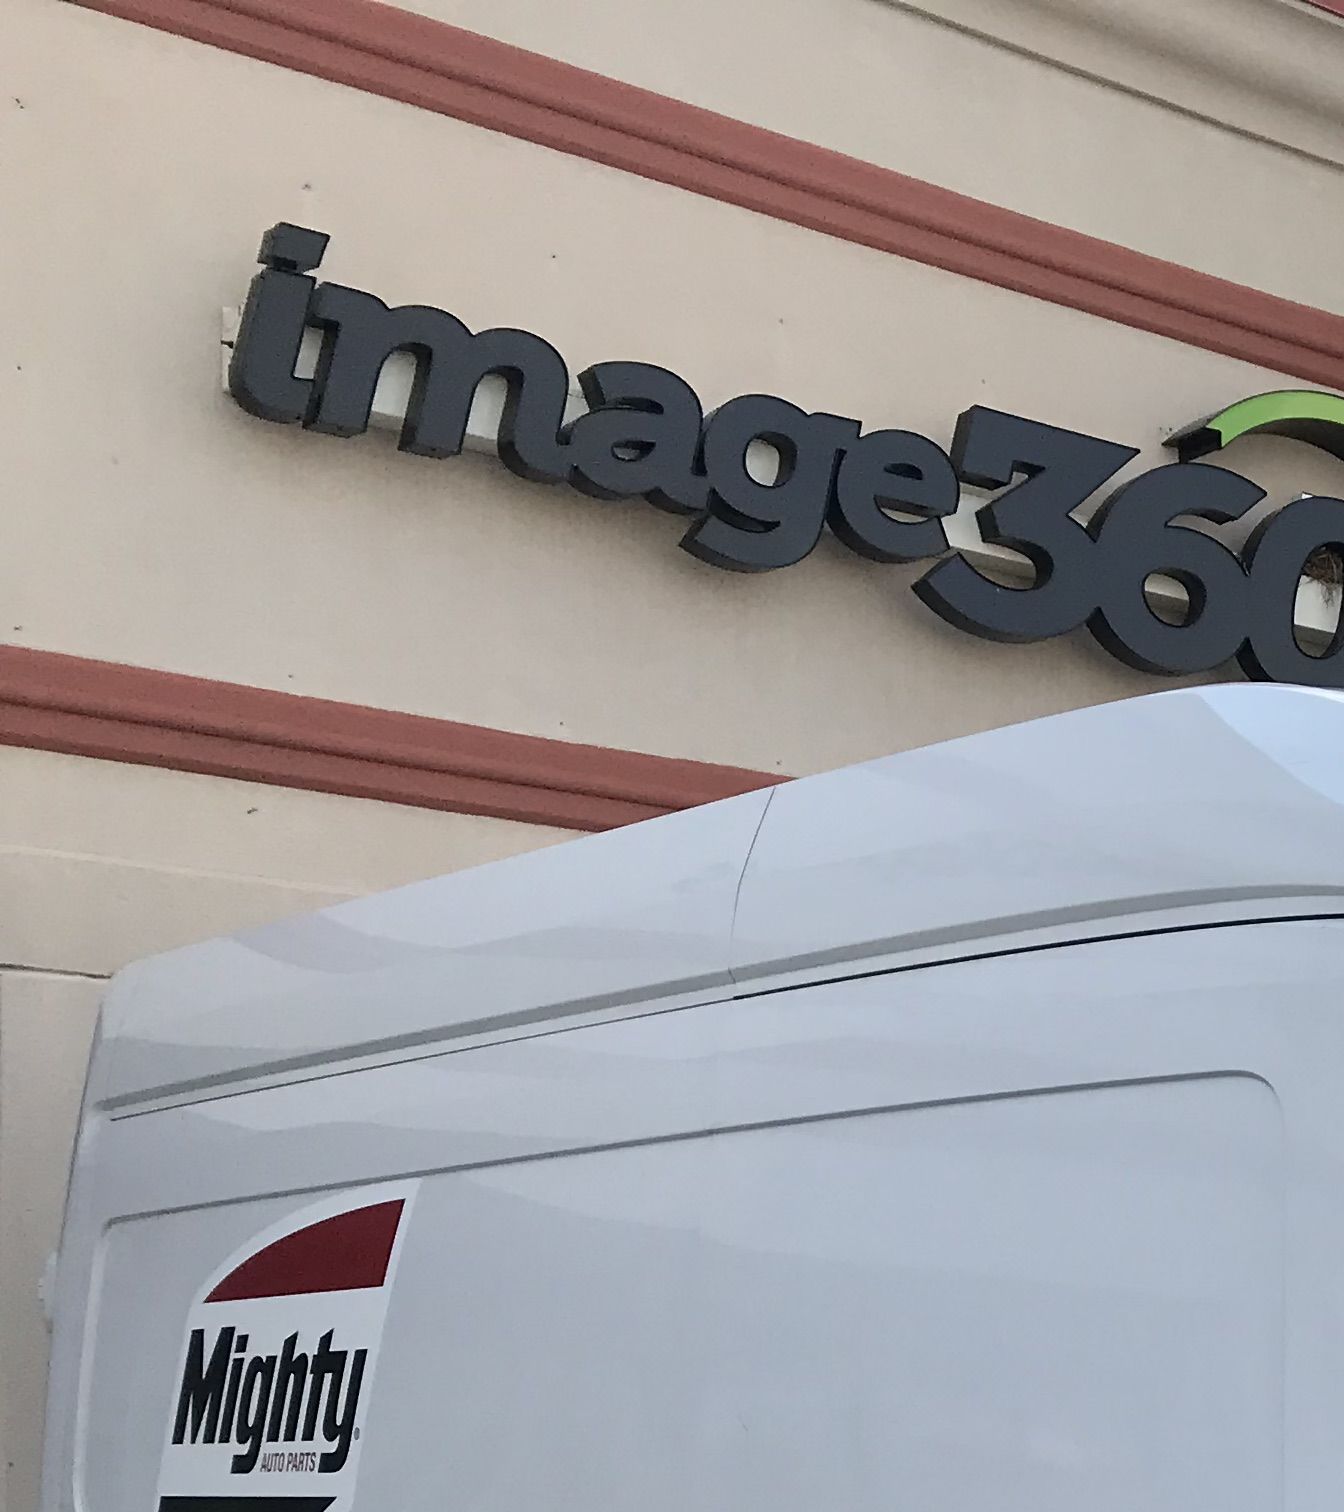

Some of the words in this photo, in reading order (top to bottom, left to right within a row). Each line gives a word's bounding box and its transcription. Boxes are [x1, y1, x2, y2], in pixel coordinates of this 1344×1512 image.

[172, 1326, 368, 1474] Mighty
[260, 1452, 285, 1473] AUTO
[286, 1452, 317, 1473] PARTS
